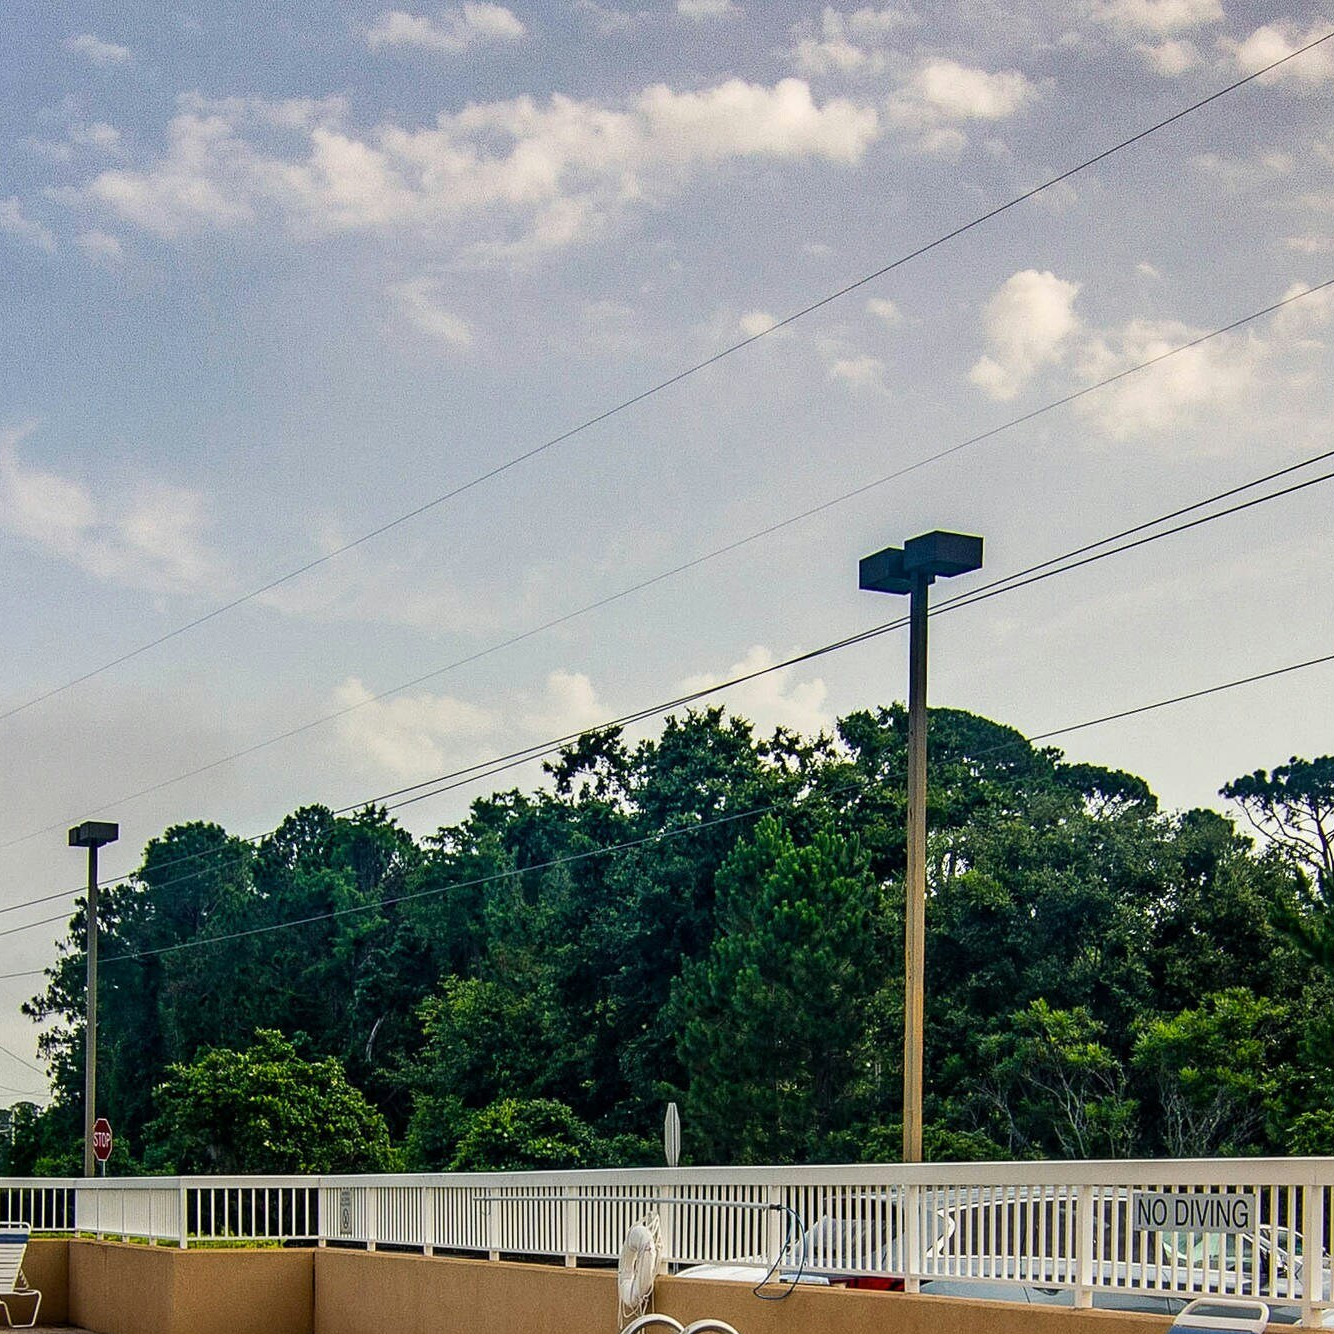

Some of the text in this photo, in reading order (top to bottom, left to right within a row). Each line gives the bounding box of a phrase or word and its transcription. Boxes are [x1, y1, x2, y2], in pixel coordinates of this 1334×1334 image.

[93, 1132, 111, 1148] STOP
[1138, 1198, 1249, 1229] NO DIVING
